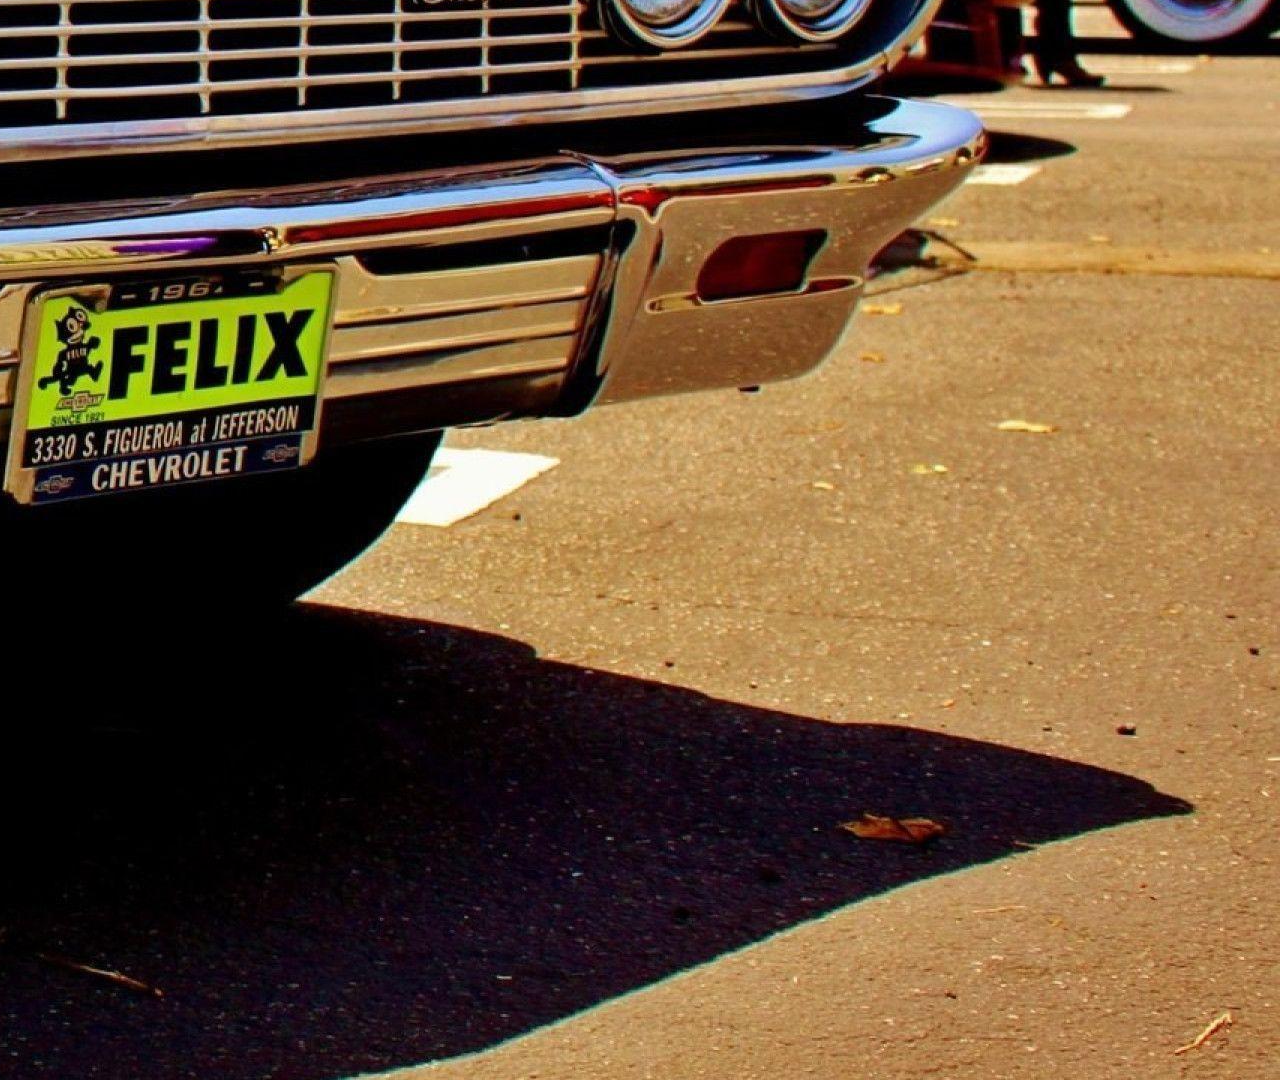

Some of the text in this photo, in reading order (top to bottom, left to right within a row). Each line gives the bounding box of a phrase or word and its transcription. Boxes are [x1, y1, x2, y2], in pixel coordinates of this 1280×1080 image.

[107, 309, 315, 400] FELIX
[31, 404, 300, 464] 3330 S. FIGUEROA at JEFFERSON
[91, 445, 248, 491] CHEVROLET
